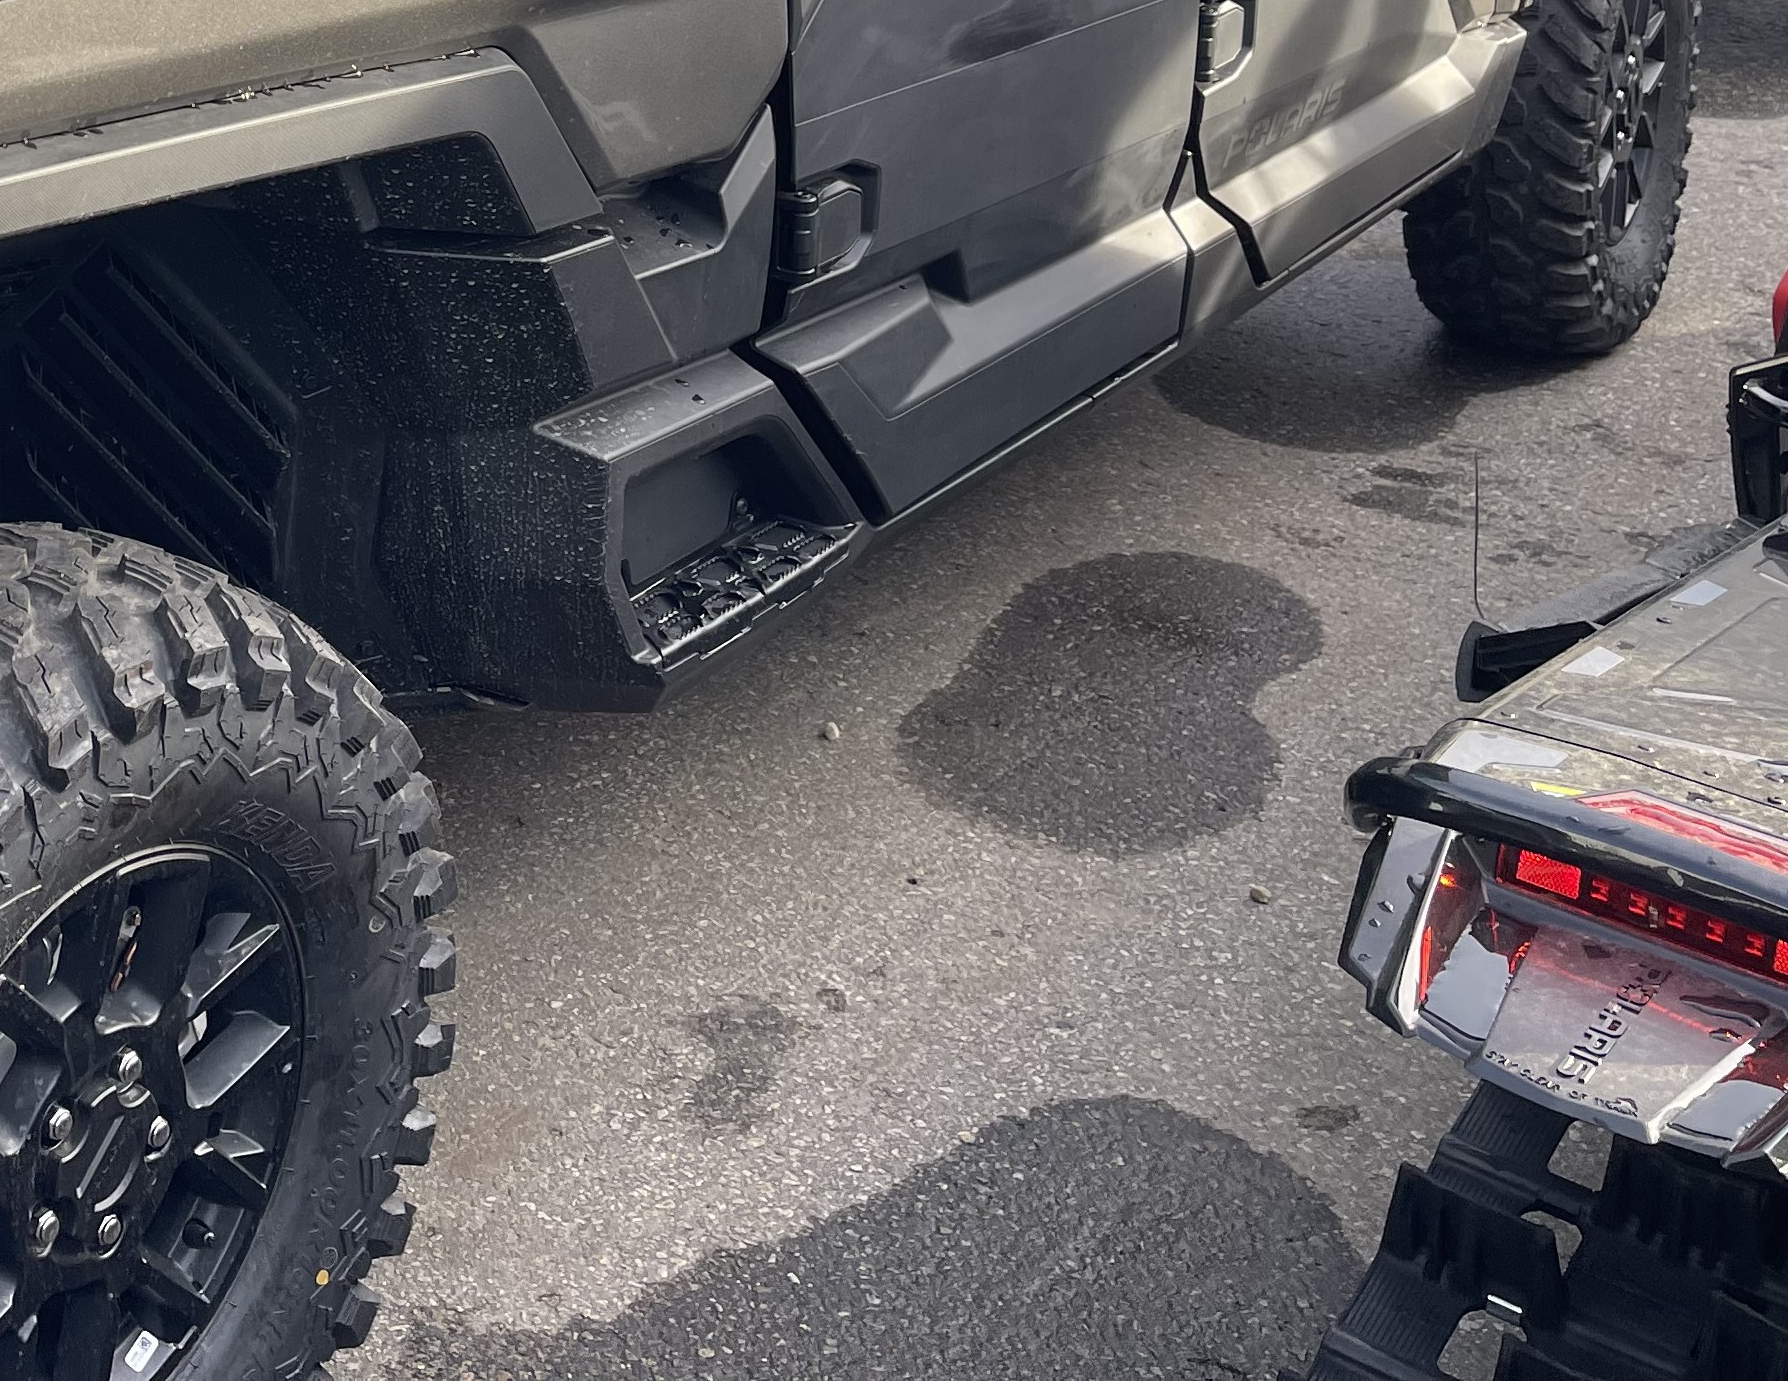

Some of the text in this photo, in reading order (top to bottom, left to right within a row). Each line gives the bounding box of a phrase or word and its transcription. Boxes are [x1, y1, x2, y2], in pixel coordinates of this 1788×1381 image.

[1223, 77, 1348, 168] POLARIS
[205, 798, 337, 894] KENDA
[1556, 963, 1672, 1085] POLARIS
